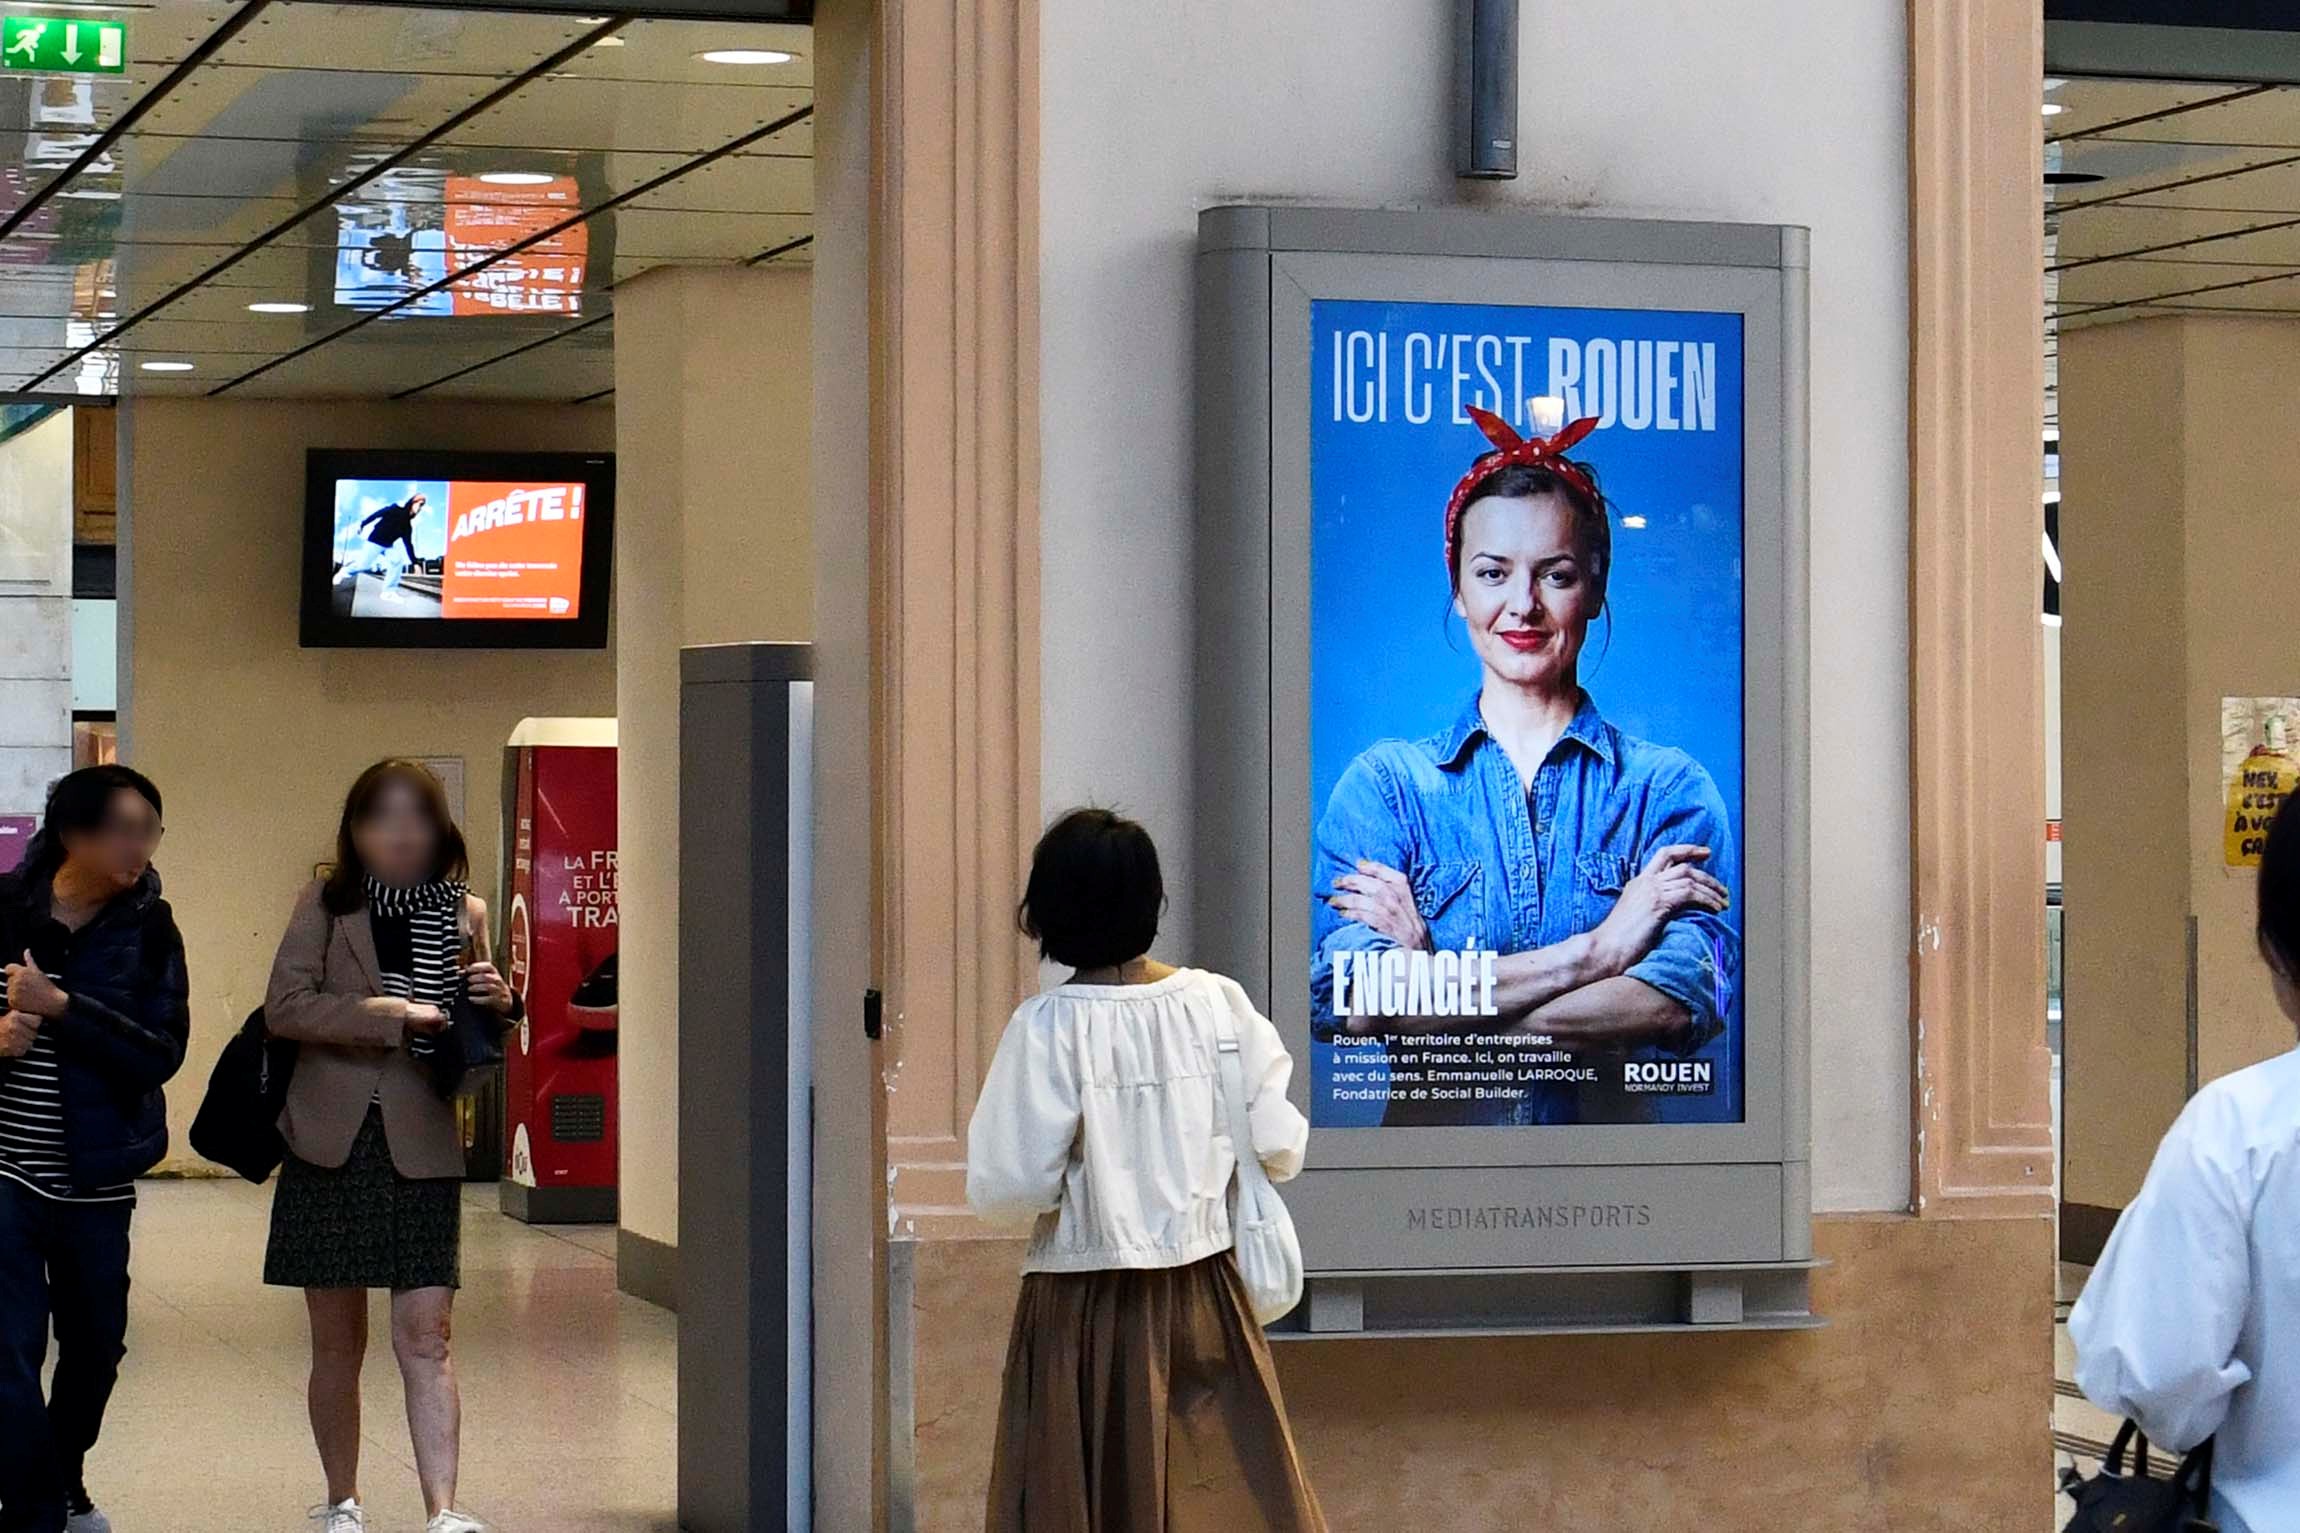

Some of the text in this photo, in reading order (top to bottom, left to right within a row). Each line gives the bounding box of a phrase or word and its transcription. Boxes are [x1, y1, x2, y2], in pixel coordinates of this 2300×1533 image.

[1333, 330, 1716, 431] ICI C'EST ROUEN
[450, 488, 567, 542] ARRÊTE
[564, 851, 618, 870] LA FR
[573, 875, 594, 889] ET
[566, 906, 619, 928] TRA
[1333, 936, 1498, 1017] ENGAGÉE
[1333, 1034, 1381, 1047] Rouen,
[1401, 1033, 1460, 1046] territoire
[1464, 1033, 1553, 1047] d'entreprises
[1333, 1051, 1572, 1064] à mission en France. Ici, on travaille
[1332, 1068, 1599, 1082] avec du sens. Emmanuelle LARROQUE,
[1624, 1063, 1711, 1082] ROUEN
[1333, 1086, 1529, 1100] Fondatrice de Social Builder.
[1624, 1083, 1710, 1093] NORMANDY INVEST
[1406, 1204, 1651, 1231] MEDIATRANSPORTS
